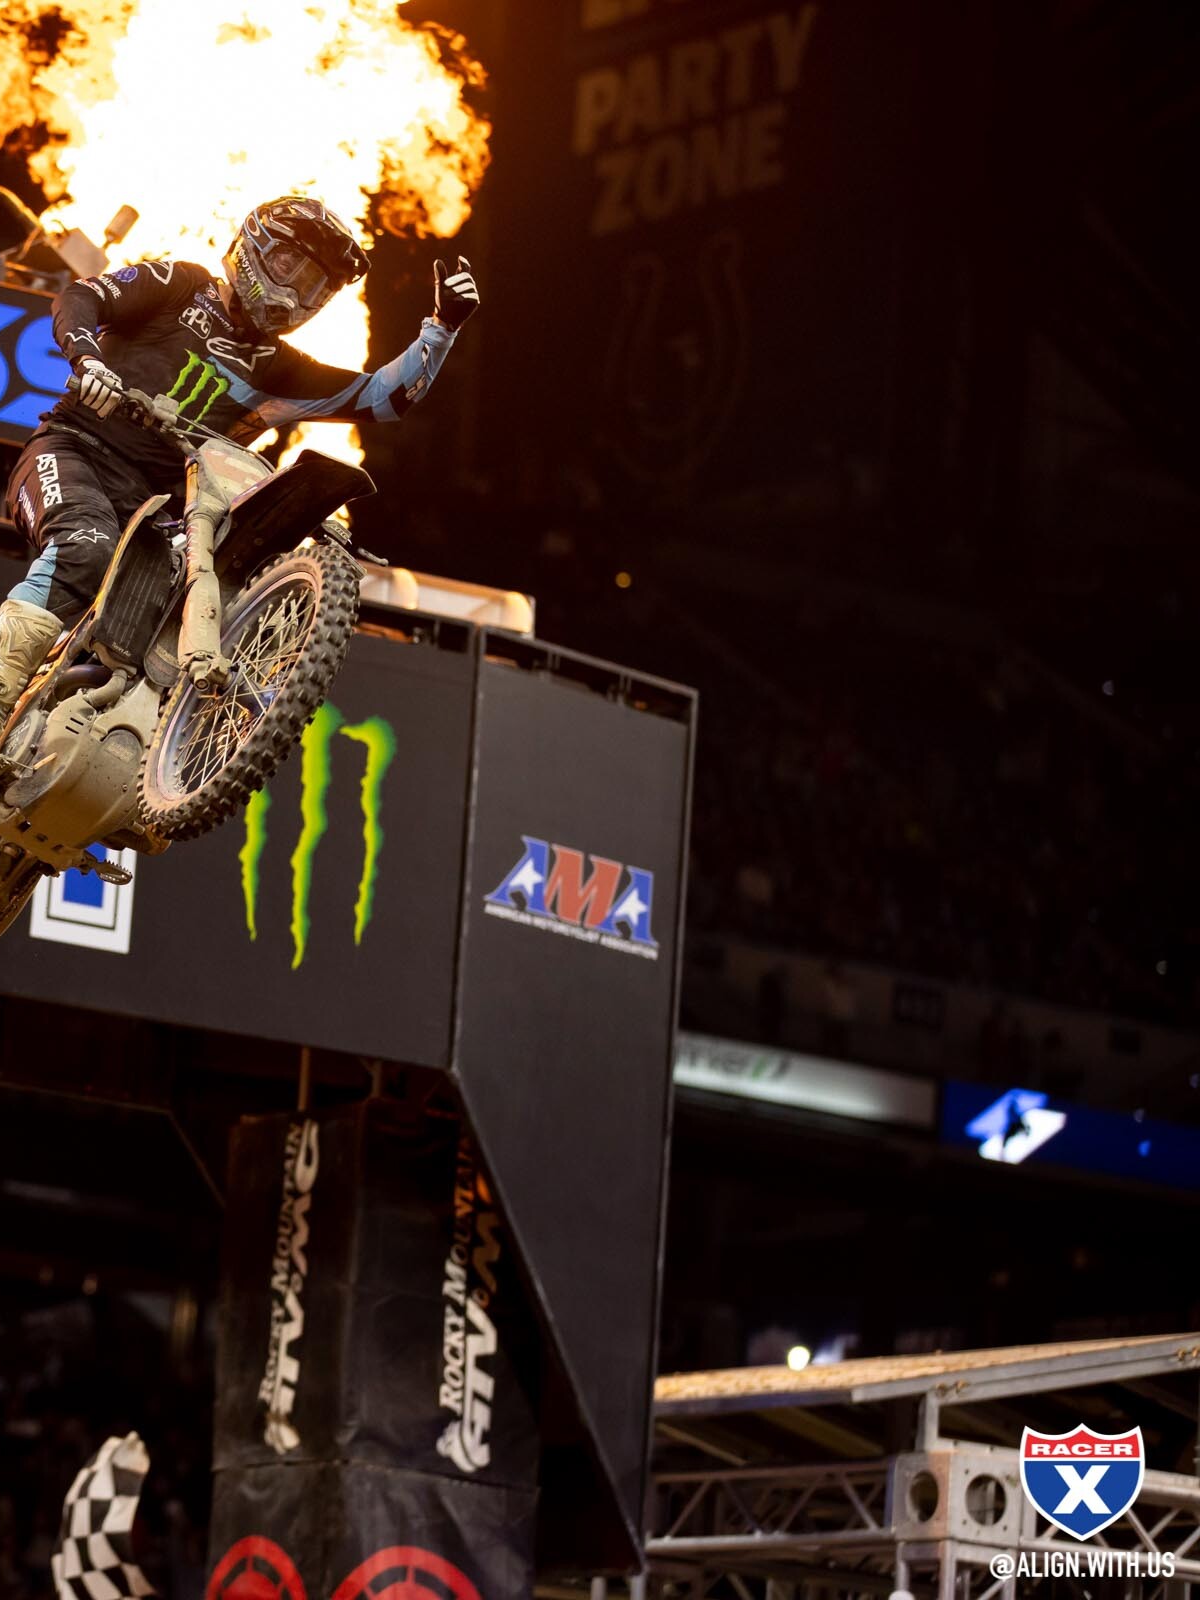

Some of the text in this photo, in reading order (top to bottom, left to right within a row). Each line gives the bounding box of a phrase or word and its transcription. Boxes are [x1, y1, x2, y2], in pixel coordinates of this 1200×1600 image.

[571, 3, 819, 157] PARTY
[593, 101, 787, 237] ZONE
[35, 453, 63, 509] ASTARS
[483, 834, 660, 949] AMA
[439, 1302, 467, 1420] ROCKY
